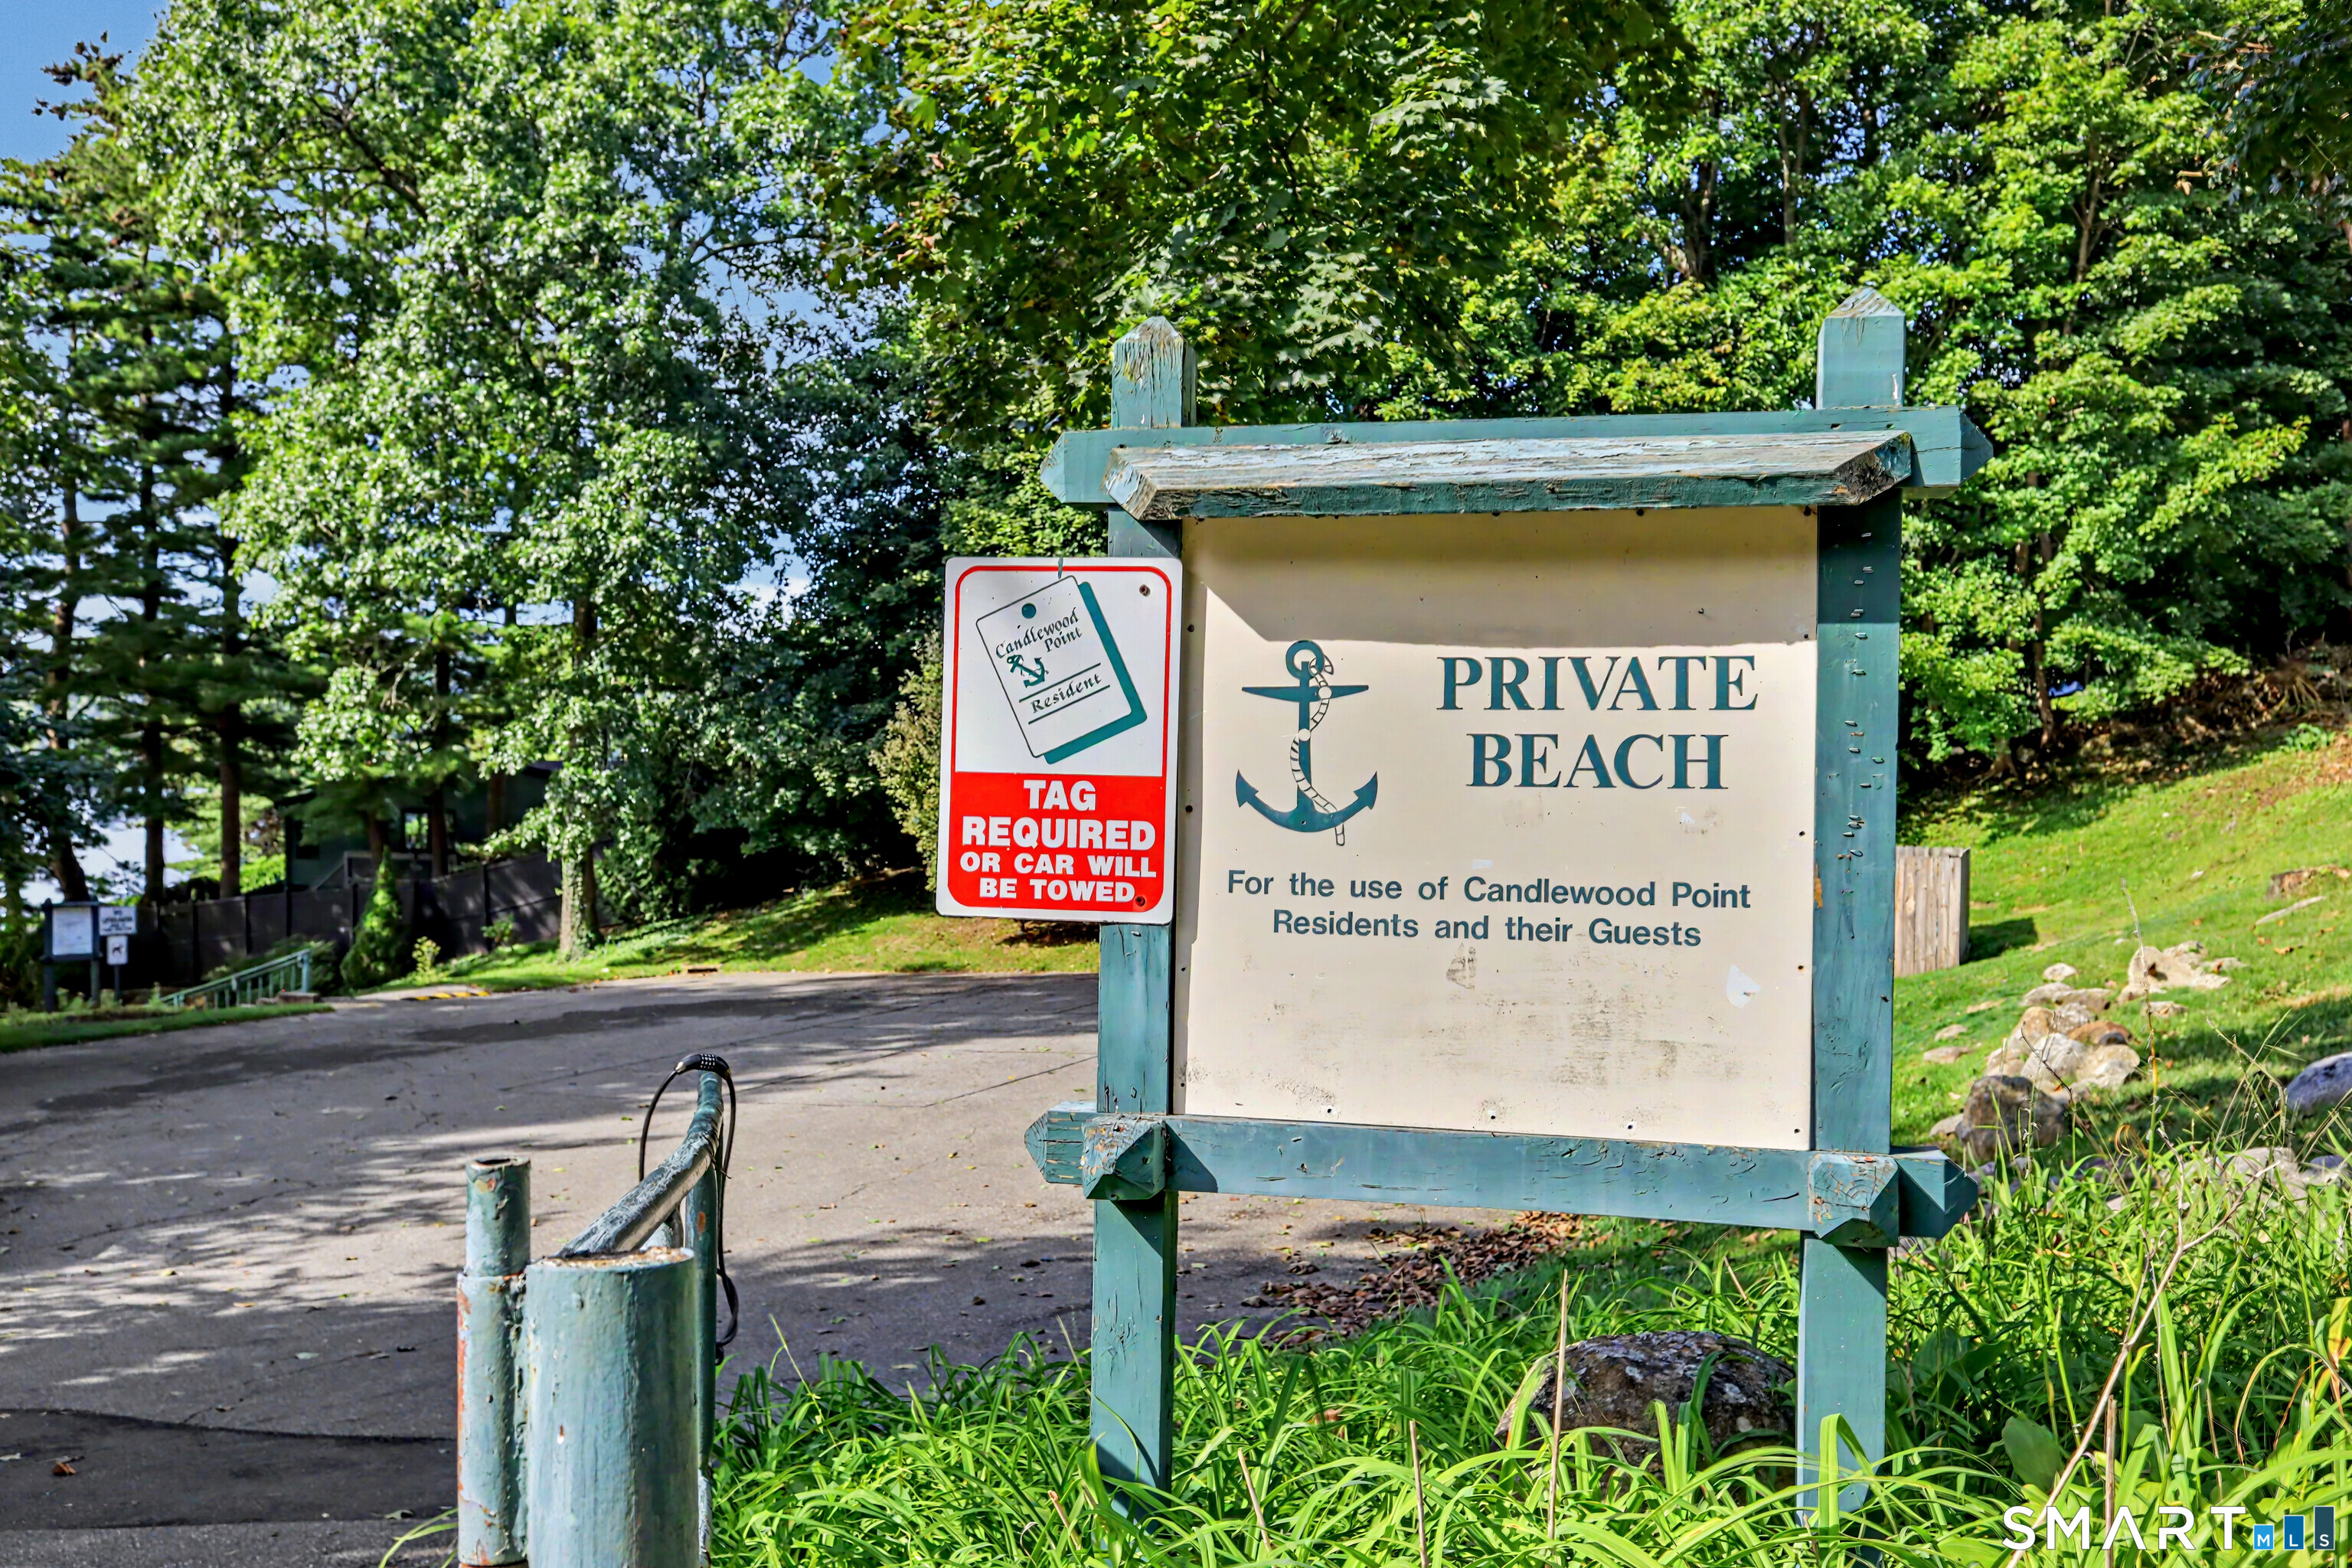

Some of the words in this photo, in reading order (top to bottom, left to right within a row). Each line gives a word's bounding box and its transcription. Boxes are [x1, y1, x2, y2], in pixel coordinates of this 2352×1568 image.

[995, 607, 1080, 658] Candlewood
[1044, 627, 1083, 654] Point
[1030, 674, 1102, 714] Resident
[1436, 655, 1758, 711] PRIVATE
[1465, 733, 1729, 789] BEACH
[1023, 779, 1096, 812] TAG
[962, 816, 1156, 851] REQUIRED
[960, 851, 1000, 873] OR
[1014, 853, 1074, 875] CAR
[1088, 855, 1157, 878] WILL
[979, 877, 1018, 899] BE
[1029, 880, 1135, 903] TOWED
[1228, 870, 1274, 895] For
[1289, 872, 1334, 898] the
[1350, 878, 1403, 900] use
[1418, 876, 1449, 902] of
[1464, 876, 1655, 907] Candlewood
[1672, 882, 1751, 910] Point
[1273, 909, 1419, 938] Residents
[1435, 916, 1489, 940] and
[1504, 916, 1571, 943] their
[1589, 919, 1702, 947] Guests
